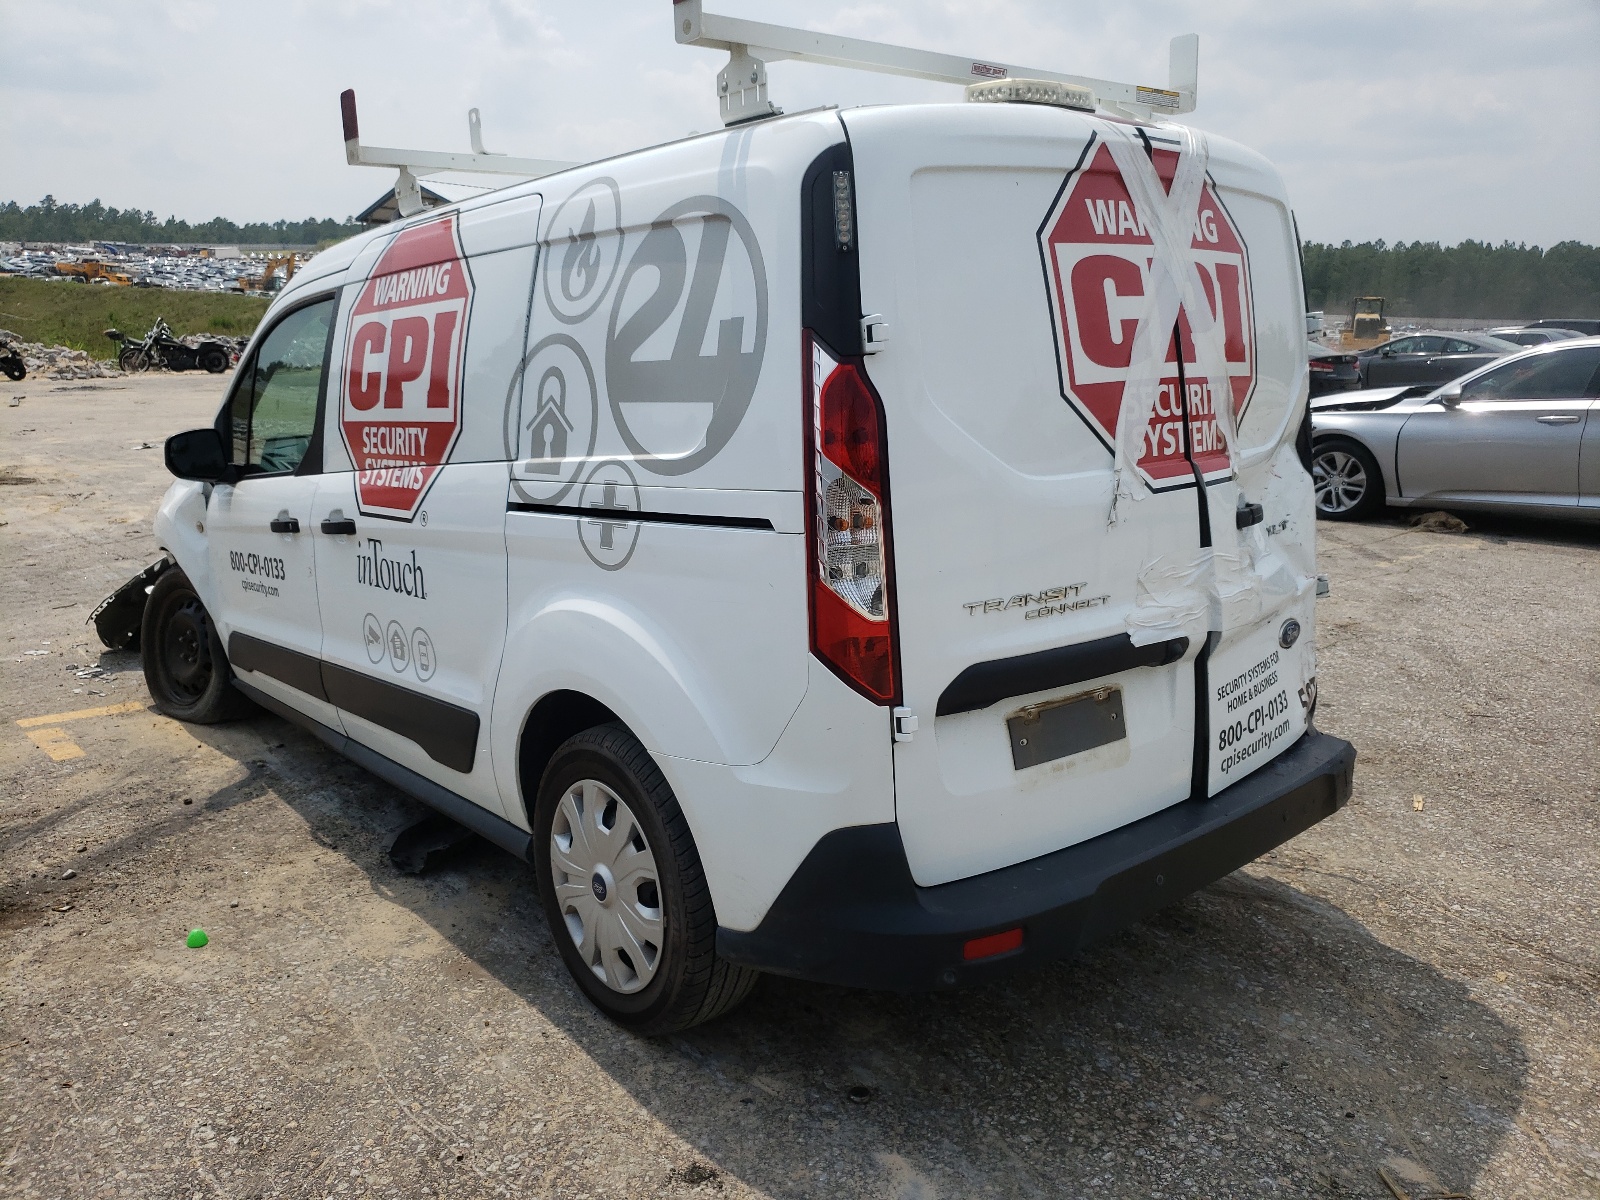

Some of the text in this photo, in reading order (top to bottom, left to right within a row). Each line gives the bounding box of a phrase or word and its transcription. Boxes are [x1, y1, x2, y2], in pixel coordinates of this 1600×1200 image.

[373, 262, 452, 306] WARNING
[348, 310, 459, 412] CPI
[362, 426, 429, 457] SECURITY
[361, 457, 428, 491] SYSTEMS
[229, 550, 286, 581] 800-CPI-0133
[356, 537, 427, 600] inTouch
[241, 579, 280, 598] cpisecurity.com
[963, 581, 1088, 617] TRANSIT
[1024, 594, 1112, 621] CONNECT
[1217, 650, 1280, 702] SECURITY SYSTEMS FOR
[1227, 692, 1248, 714] HOME
[1248, 688, 1254, 701] &
[1254, 670, 1279, 698] BUSINESS
[1218, 689, 1289, 752] 800-CPI-0133
[1221, 718, 1290, 775] cpisecurity.com
